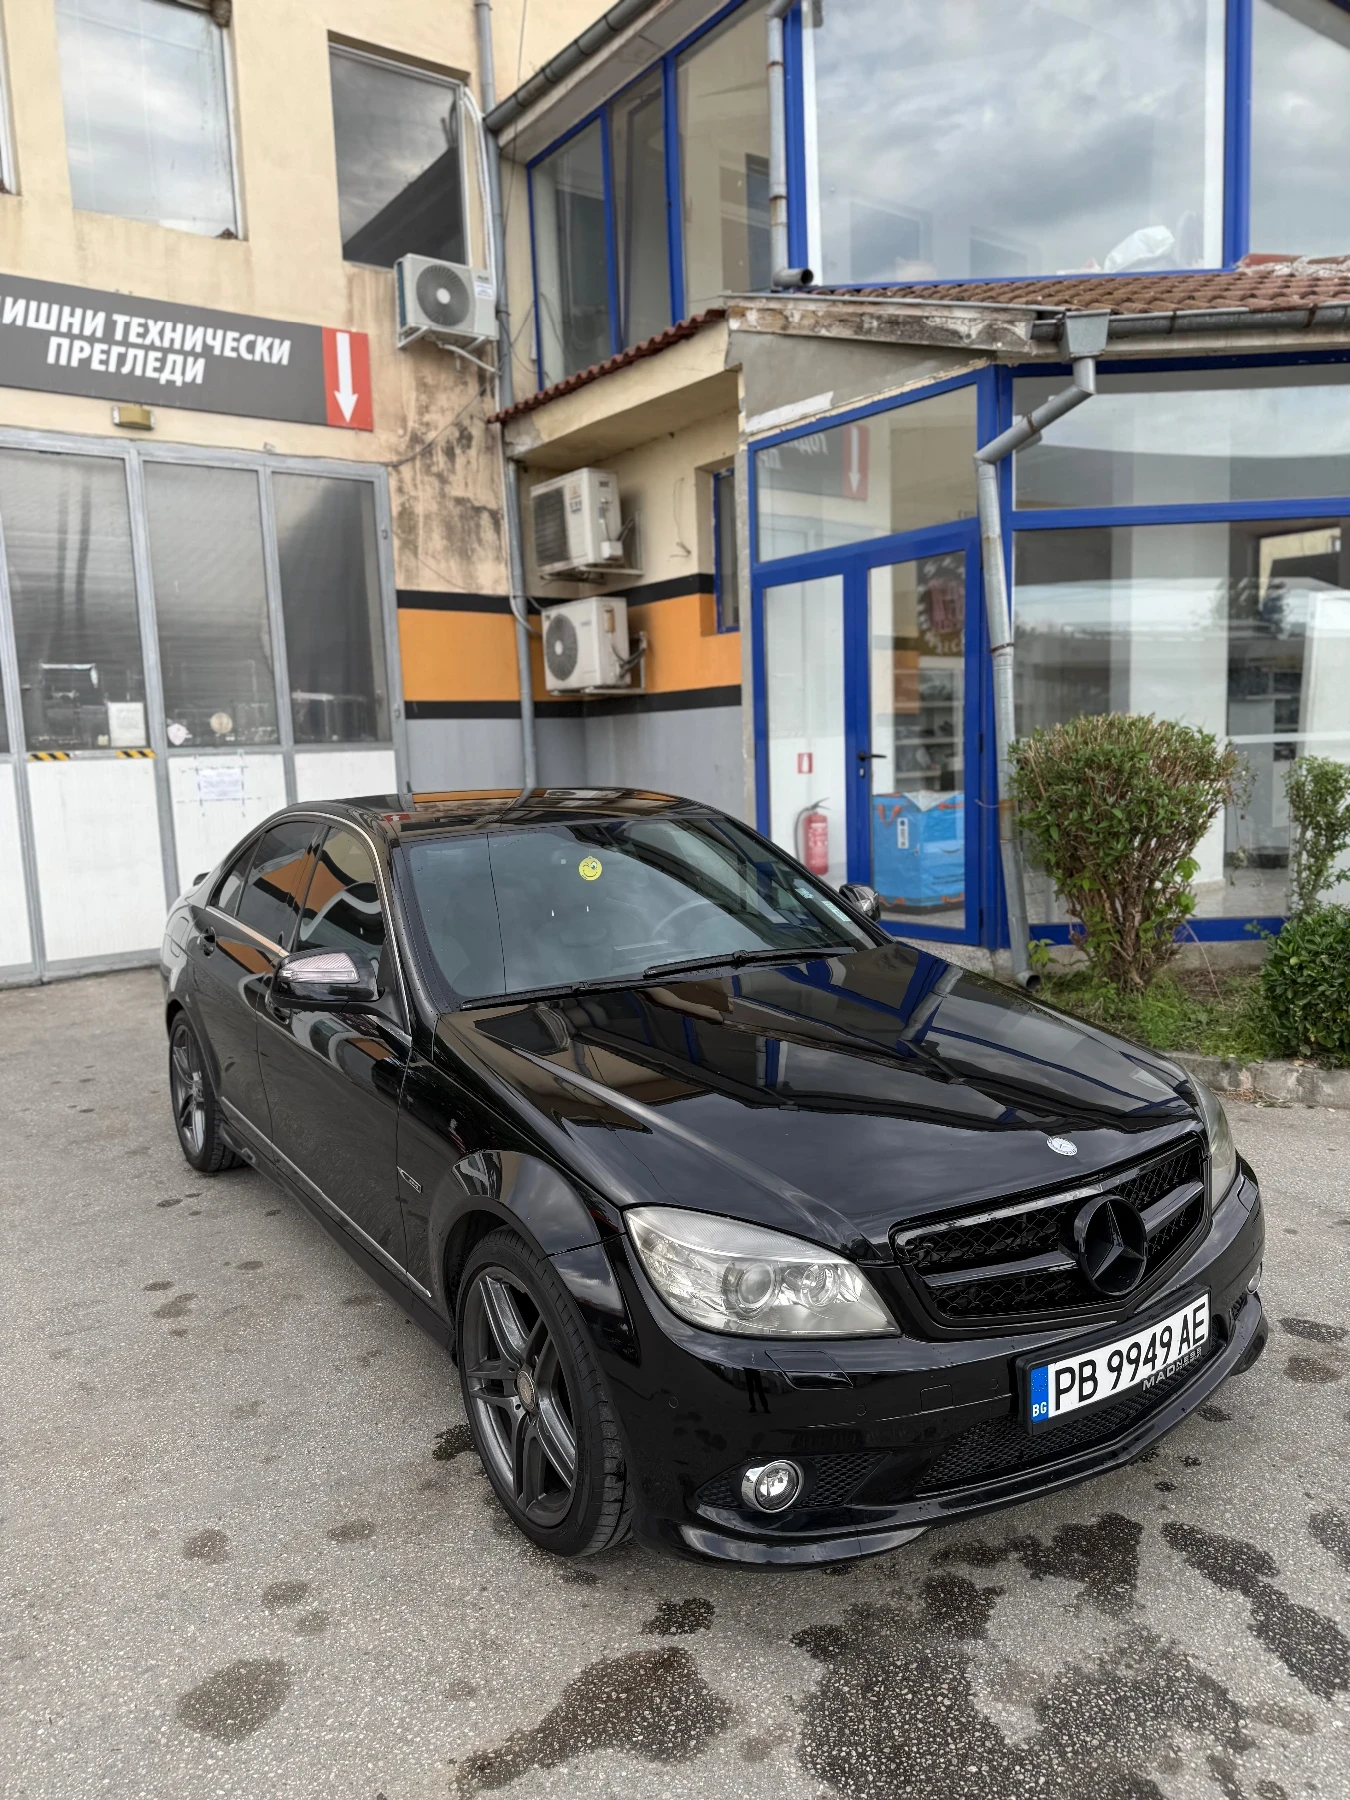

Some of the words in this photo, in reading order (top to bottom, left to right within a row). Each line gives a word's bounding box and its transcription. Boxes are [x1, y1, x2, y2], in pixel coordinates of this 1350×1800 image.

[0, 296, 106, 338] ИШНИ
[112, 313, 291, 366] ТЕХНИЧЕСКИ
[47, 336, 205, 387] ПРЕГЛЕДИ
[1054, 1359, 1098, 1411] PB
[1107, 1325, 1173, 1390] 9949
[1178, 1301, 1206, 1356] AE
[1032, 1401, 1048, 1418] BG
